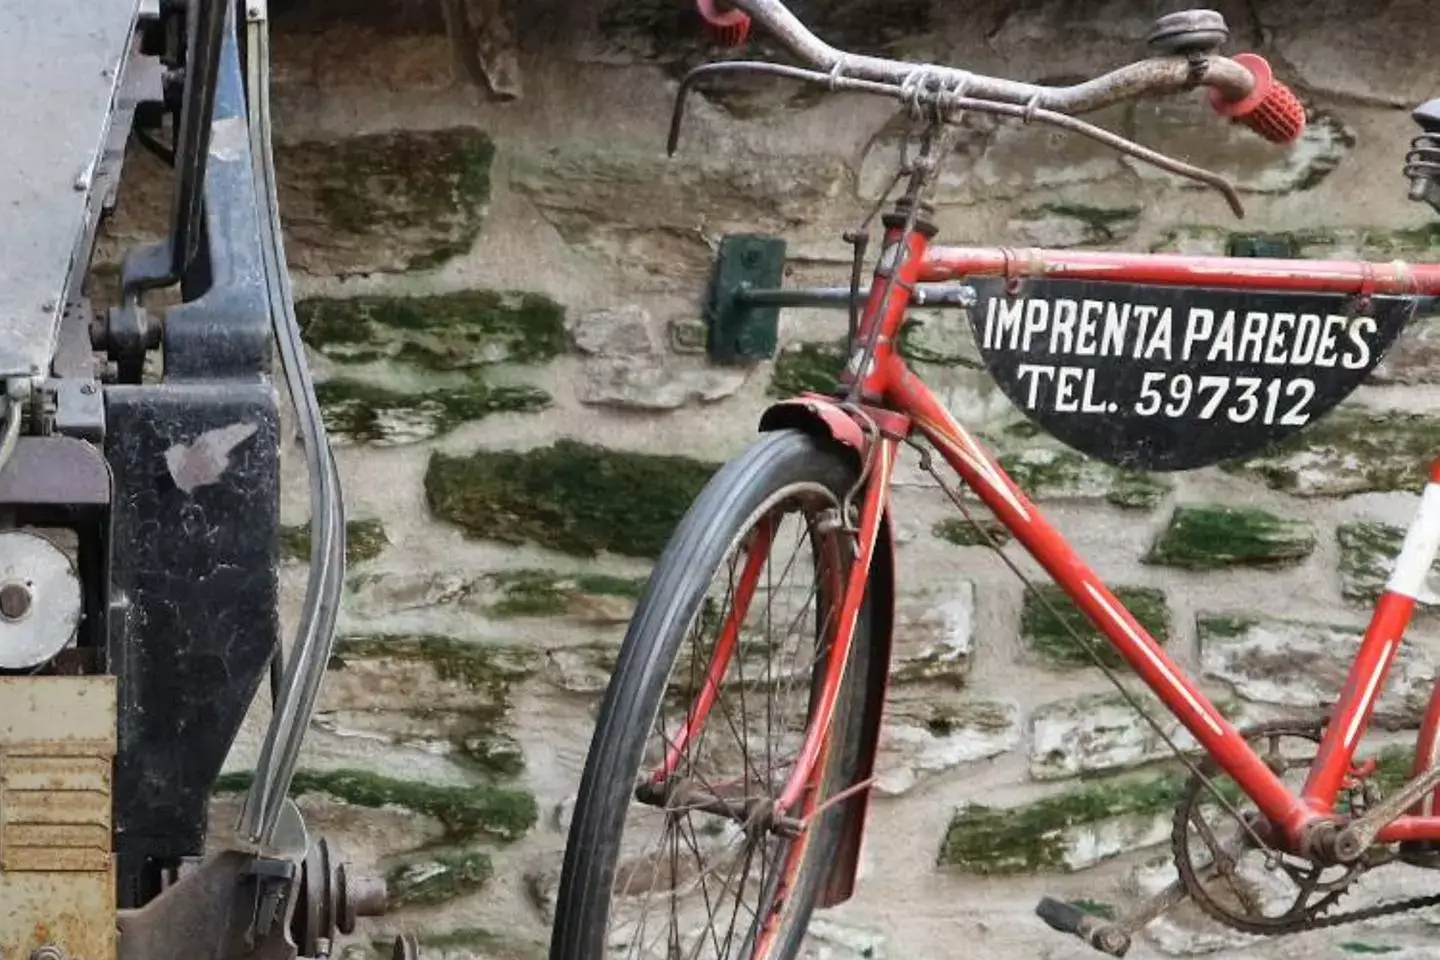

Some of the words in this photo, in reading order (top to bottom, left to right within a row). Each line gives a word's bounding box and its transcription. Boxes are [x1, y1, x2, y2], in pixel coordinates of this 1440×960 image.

[982, 297, 1173, 360] IMPRENTA
[1182, 308, 1378, 370] PAREDES
[1016, 364, 1118, 414] TEL.
[1135, 371, 1317, 426] 597312
